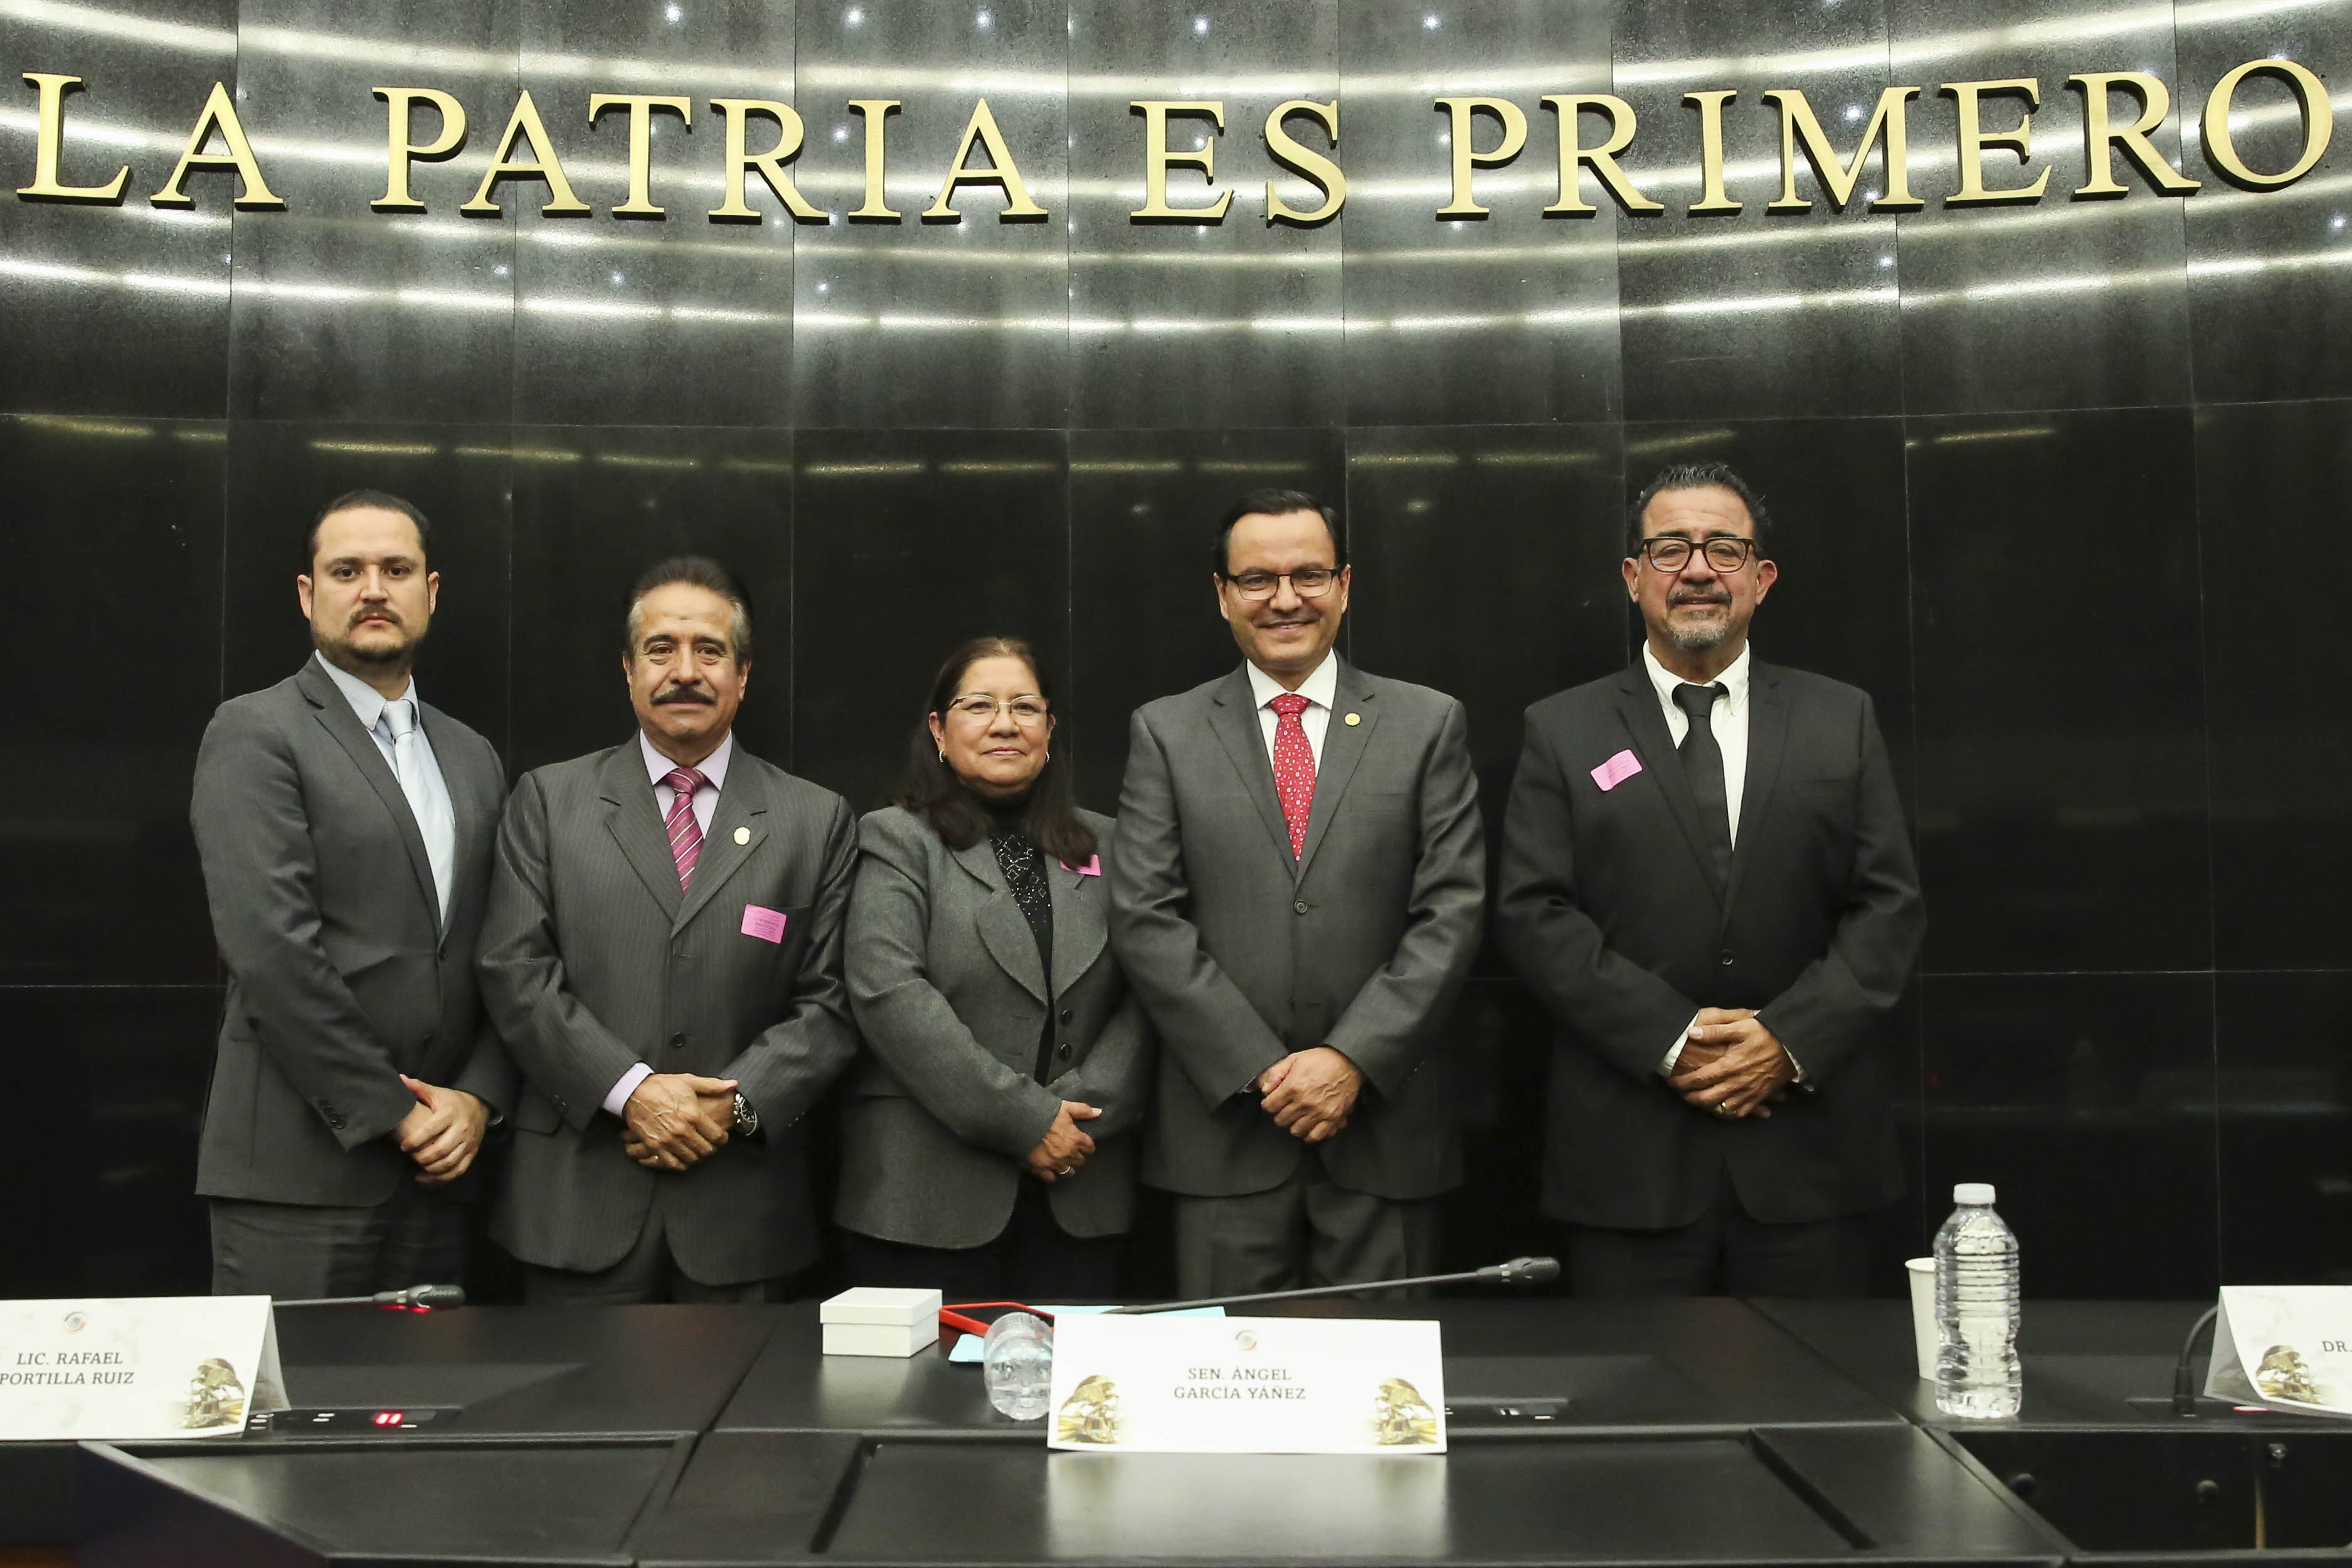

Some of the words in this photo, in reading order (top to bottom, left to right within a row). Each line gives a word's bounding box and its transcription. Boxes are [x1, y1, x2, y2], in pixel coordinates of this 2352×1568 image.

[17, 72, 287, 210] LA
[369, 87, 1049, 223] PATRIA
[1129, 98, 1347, 228] ES
[1434, 58, 2333, 220] PRIMERO
[17, 1352, 49, 1365] LIC.
[56, 1352, 123, 1365] RAFAEL
[0, 1372, 85, 1385] PORTILLA
[92, 1372, 134, 1384] RUIZ
[1188, 1368, 1224, 1380] SEN.
[1232, 1366, 1291, 1380] ÁNGEL
[1174, 1385, 1241, 1399] GARCÍA
[1248, 1385, 1306, 1399] YÁÑEZ
